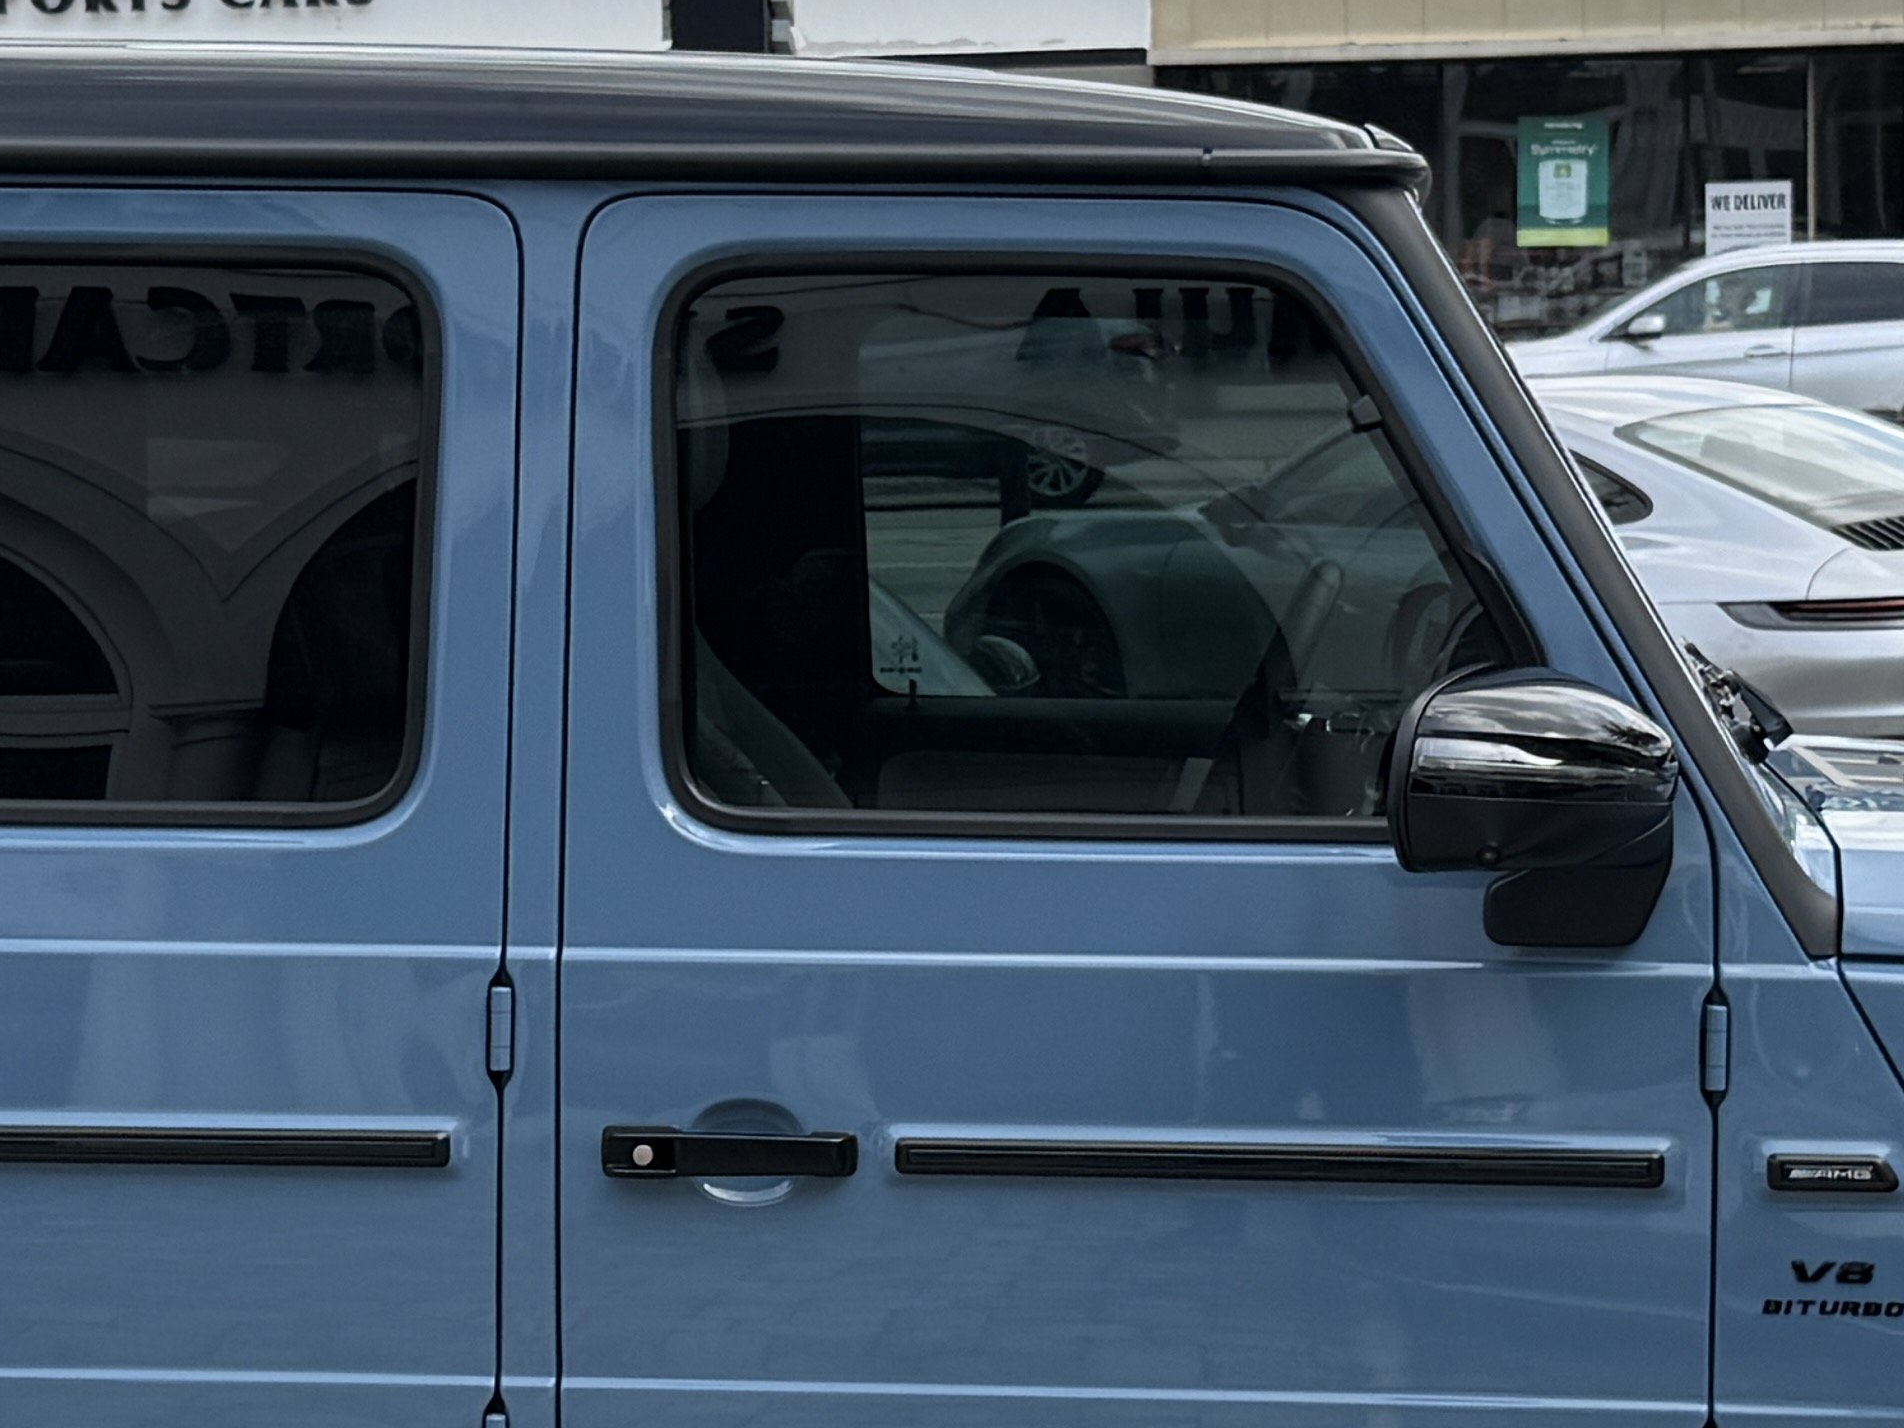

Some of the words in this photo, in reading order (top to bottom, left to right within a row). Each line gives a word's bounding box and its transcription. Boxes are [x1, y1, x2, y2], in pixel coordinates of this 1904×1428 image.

[1712, 194, 1731, 212] WE
[1734, 192, 1786, 211] DELIVER
[1791, 1260, 1875, 1284] V8
